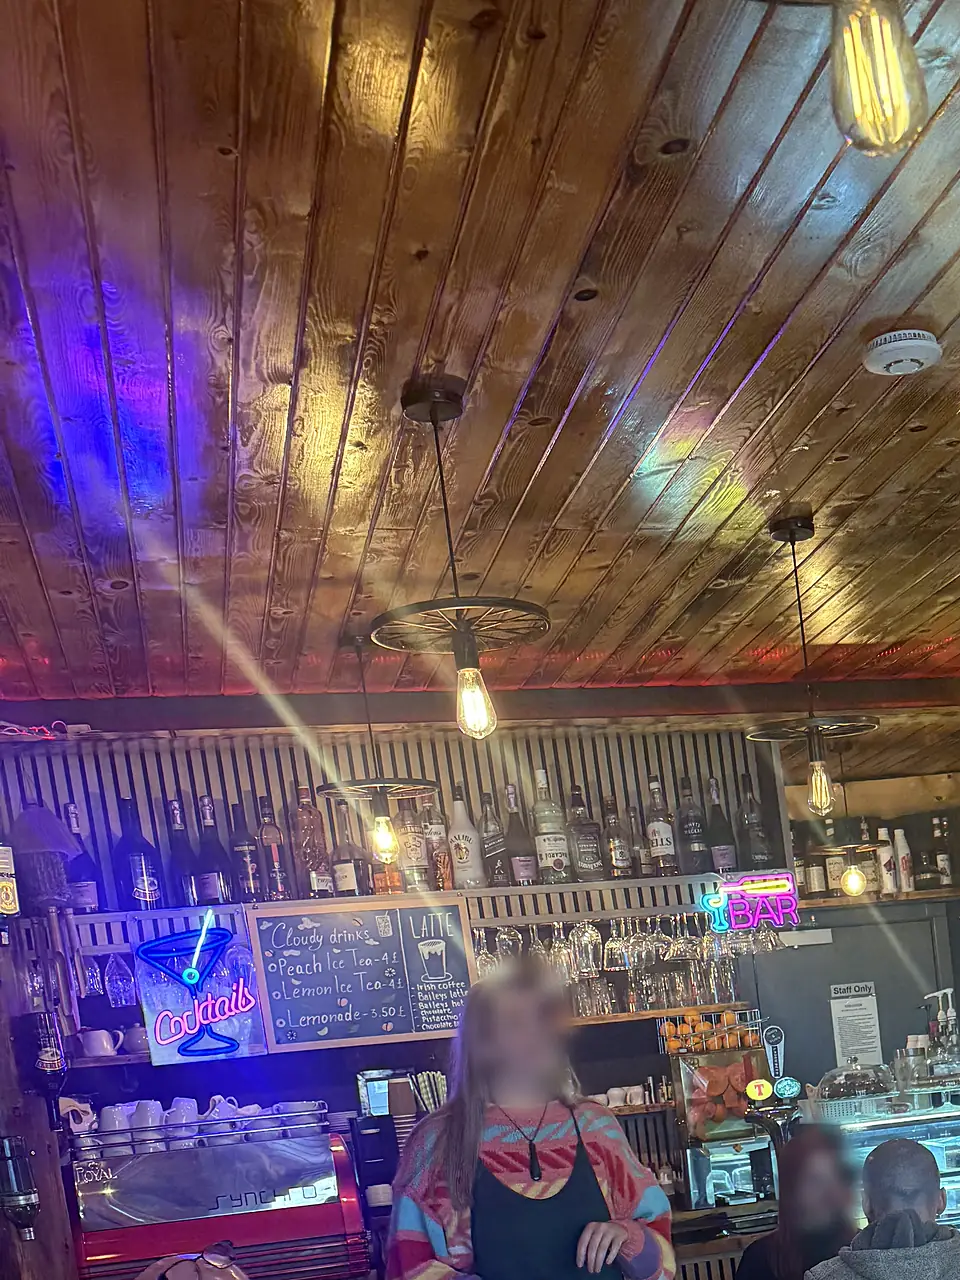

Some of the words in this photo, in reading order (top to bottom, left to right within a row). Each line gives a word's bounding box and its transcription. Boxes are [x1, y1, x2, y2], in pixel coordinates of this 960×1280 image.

[728, 895, 798, 930] BAR
[271, 922, 323, 950] Cloudy
[330, 929, 370, 944] drinks
[409, 912, 454, 939] LATTE
[278, 954, 322, 976] Peach
[327, 952, 345, 970] Ice
[392, 952, 399, 964] £
[282, 981, 332, 1000] Lemon
[334, 975, 353, 994] Ice
[417, 983, 436, 991] Irish
[438, 981, 466, 990] coffee
[417, 991, 448, 1001] Baileys
[449, 987, 469, 998] latte
[833, 986, 852, 995] Staff
[853, 984, 872, 994] Only
[154, 977, 256, 1045] Cocktails
[287, 1004, 361, 1028] Lemonade
[418, 1001, 448, 1010] Baileys
[754, 1083, 765, 1097] T
